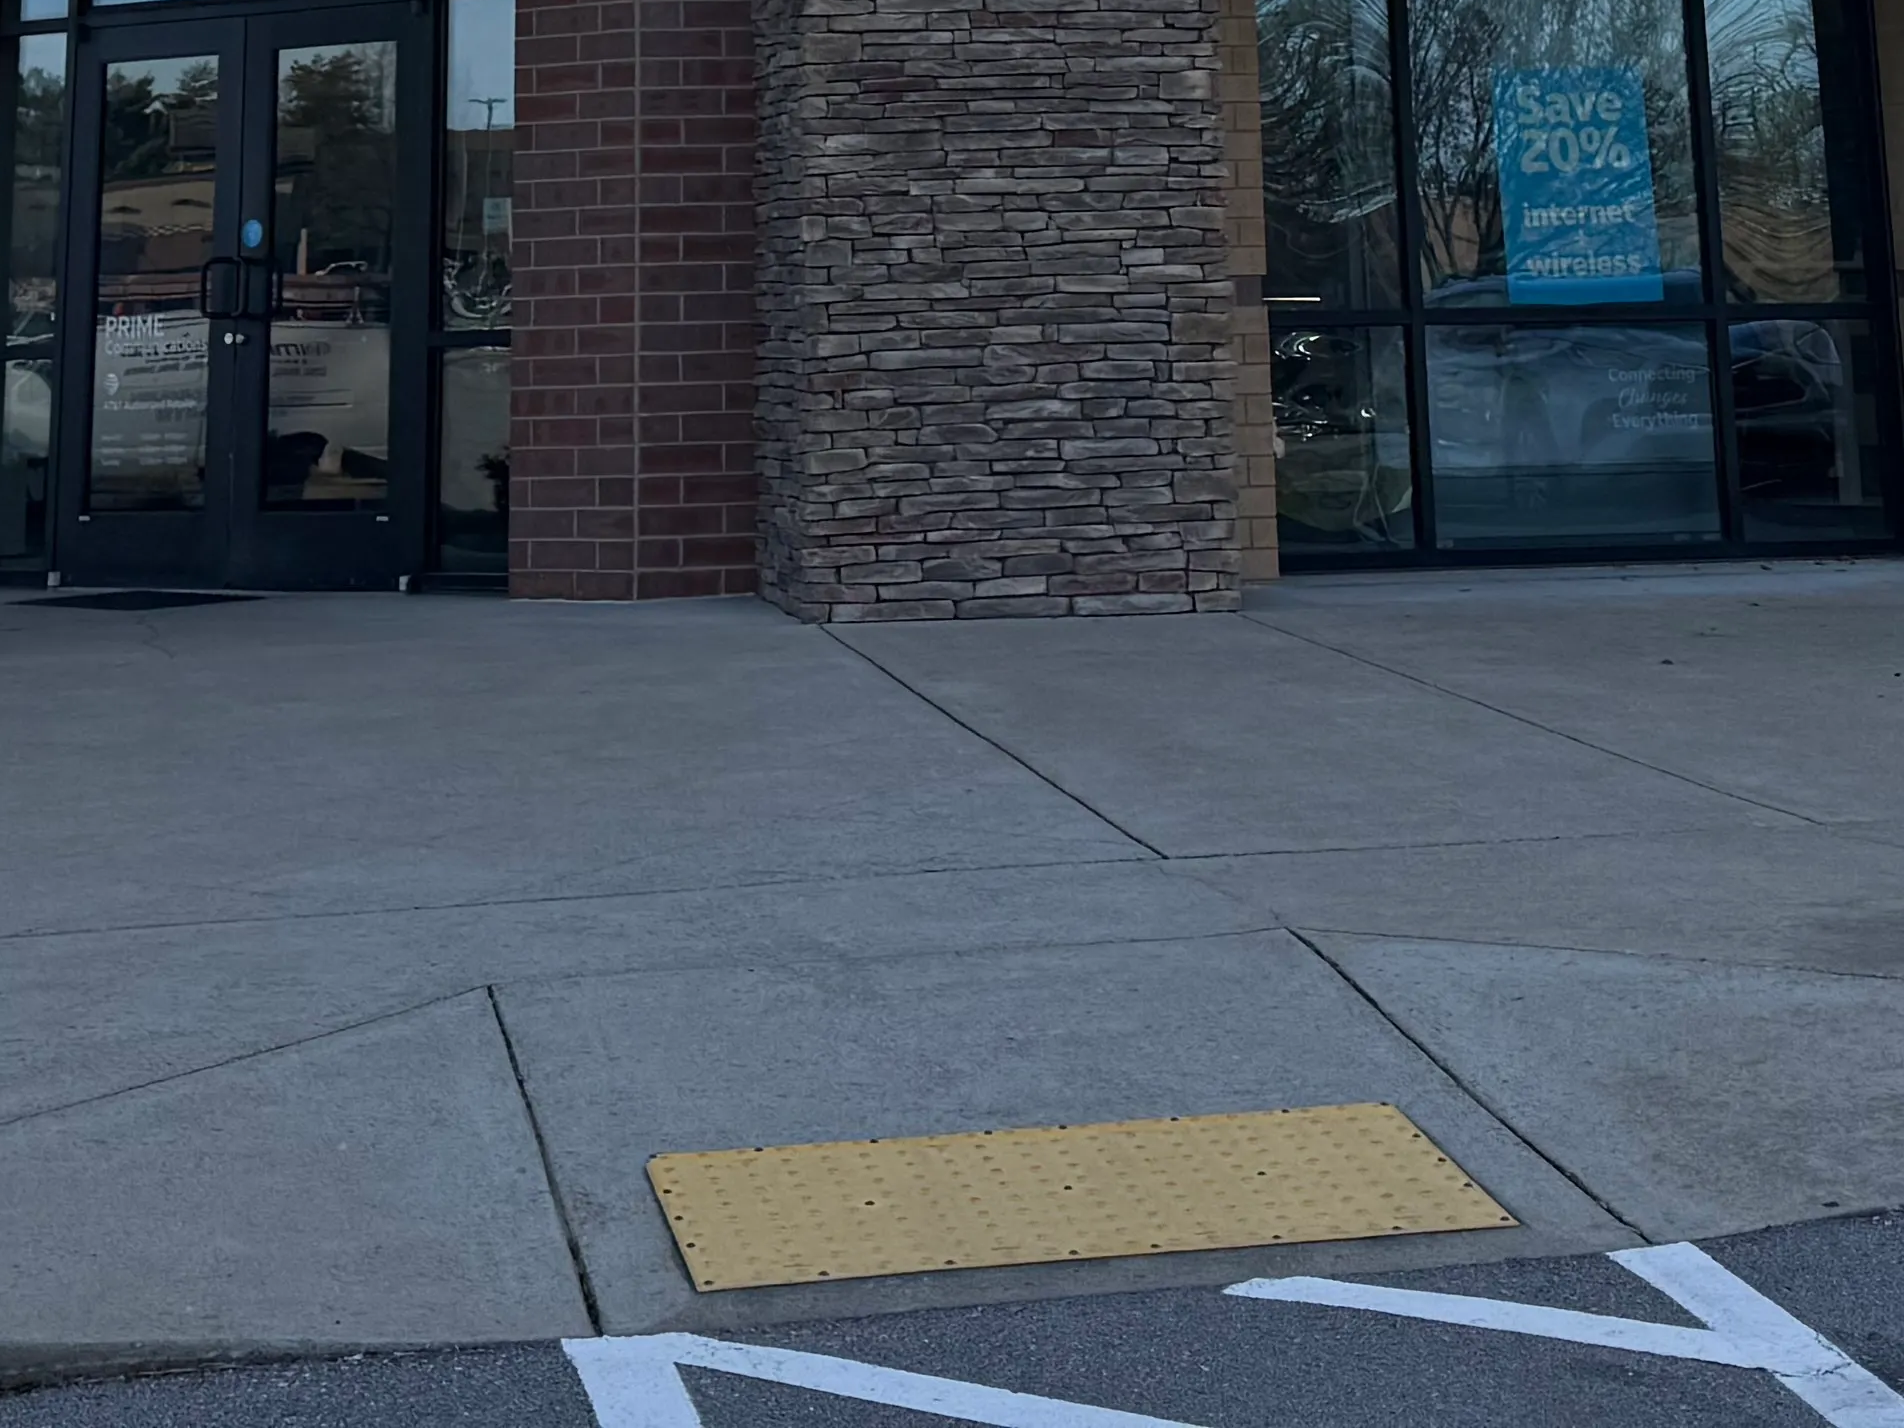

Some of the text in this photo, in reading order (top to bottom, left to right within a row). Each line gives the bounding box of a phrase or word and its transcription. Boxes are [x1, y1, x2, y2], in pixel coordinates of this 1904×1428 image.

[1516, 84, 1623, 126] Save
[1520, 126, 1631, 174] 20%
[1522, 201, 1636, 228] internet
[1526, 249, 1642, 277] wireless
[104, 314, 166, 339] PRIME
[1608, 365, 1697, 383] Connecting
[1612, 410, 1700, 431] Everything
